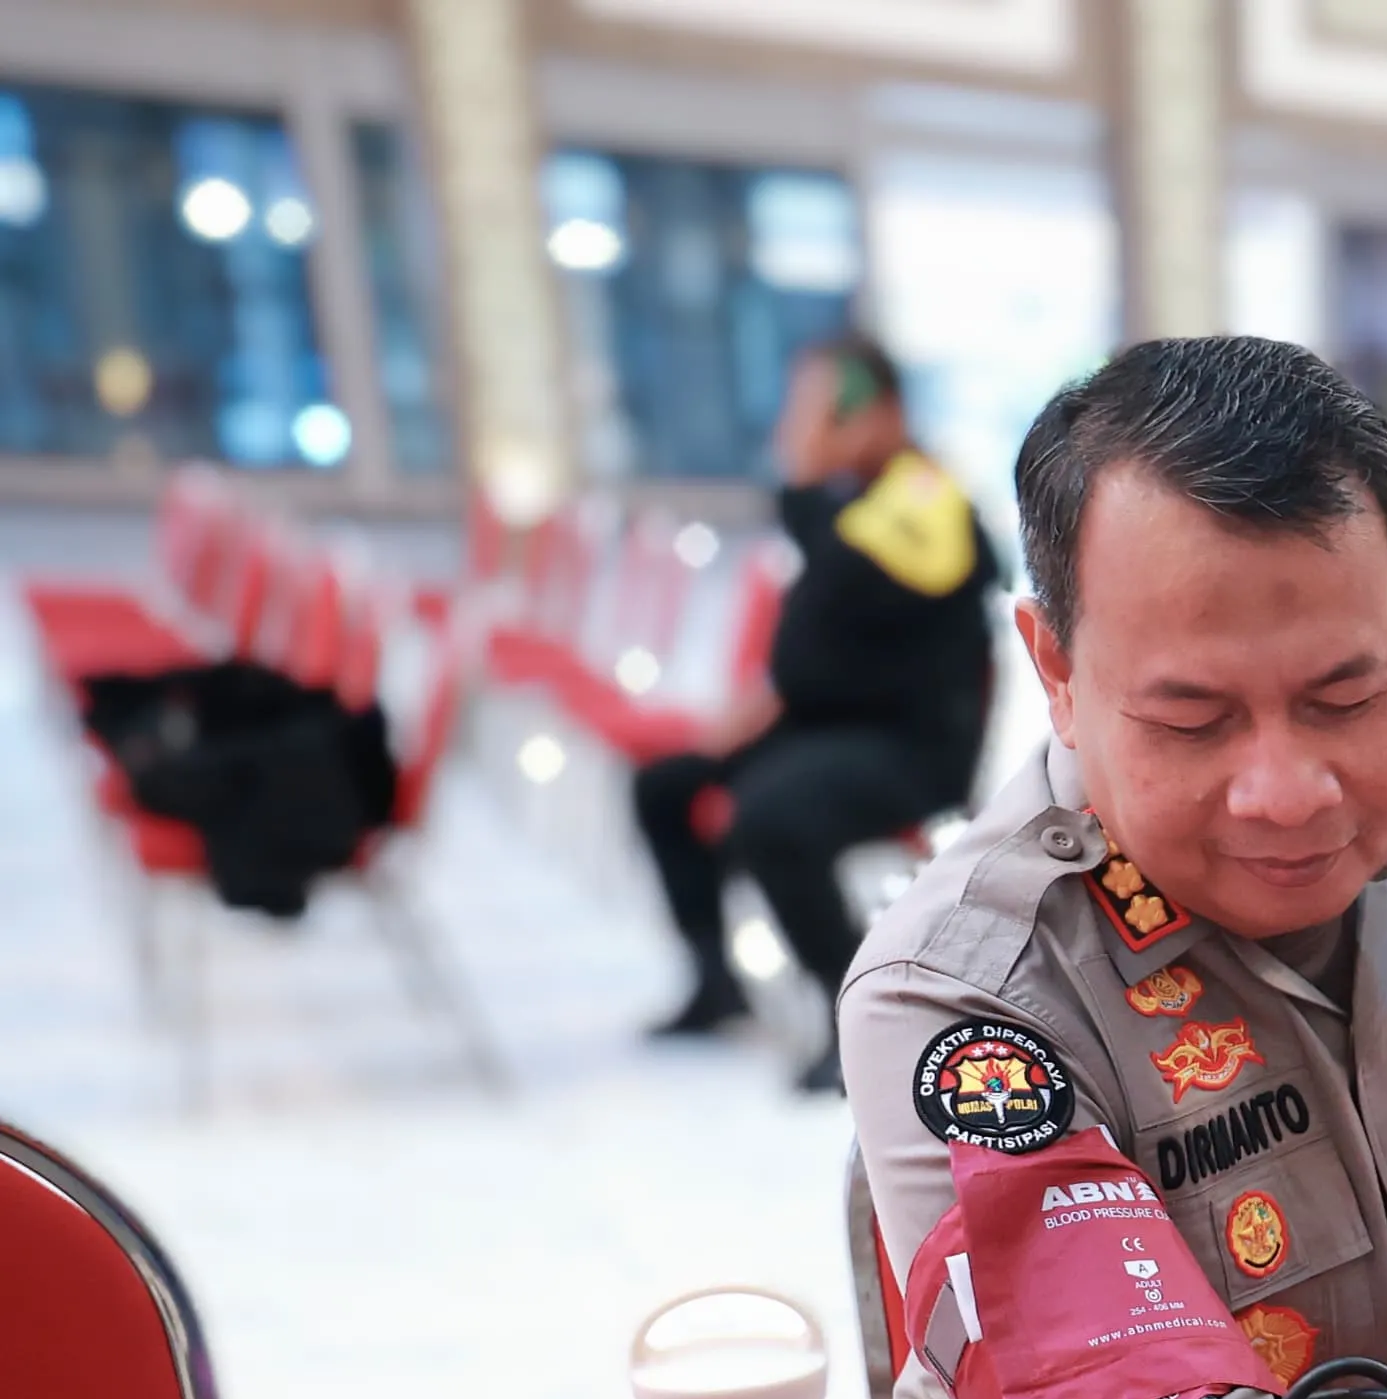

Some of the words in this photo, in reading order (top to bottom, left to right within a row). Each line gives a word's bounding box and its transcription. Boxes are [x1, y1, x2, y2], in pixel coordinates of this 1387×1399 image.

[920, 1027, 974, 1097] OBYEKTIF
[982, 1025, 1067, 1091] DIPERCAYA
[945, 1119, 1058, 1149] PARTISIPASI
[1157, 1083, 1310, 1191] DIRMANTO
[1041, 1182, 1136, 1212] ABN
[1044, 1209, 1092, 1230] BLOOD
[1093, 1206, 1153, 1219] PRESSURE
[1088, 1316, 1227, 1348] www.abnmedical.com
